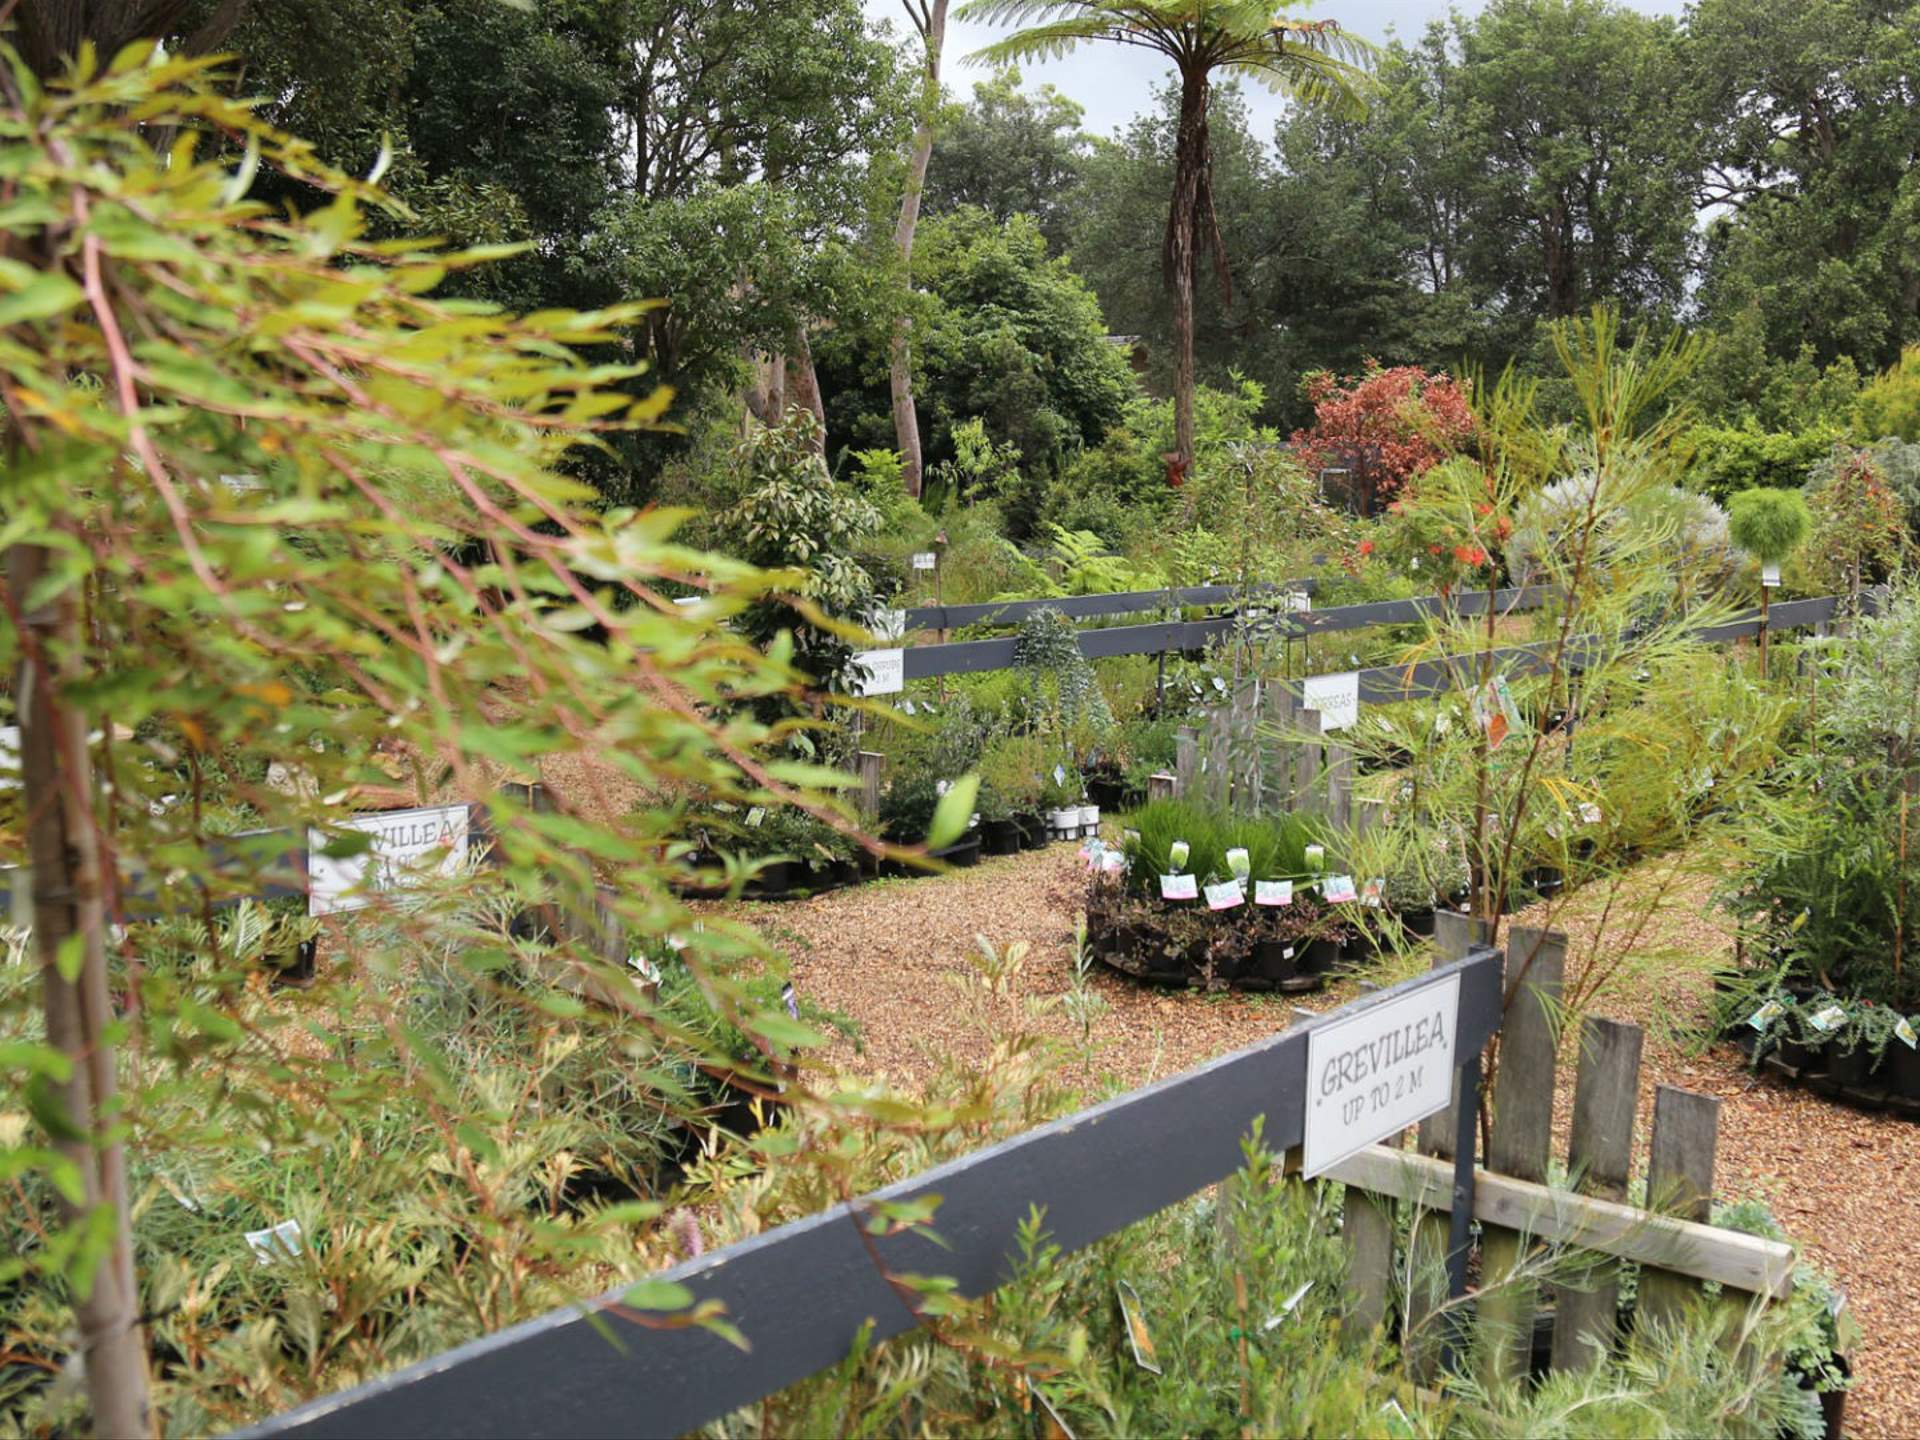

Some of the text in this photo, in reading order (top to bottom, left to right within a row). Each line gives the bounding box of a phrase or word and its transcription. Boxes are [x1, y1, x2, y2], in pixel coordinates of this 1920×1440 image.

[1321, 1011, 1445, 1096] GREVILLEA
[1343, 1066, 1424, 1125] UP TO 2 M
